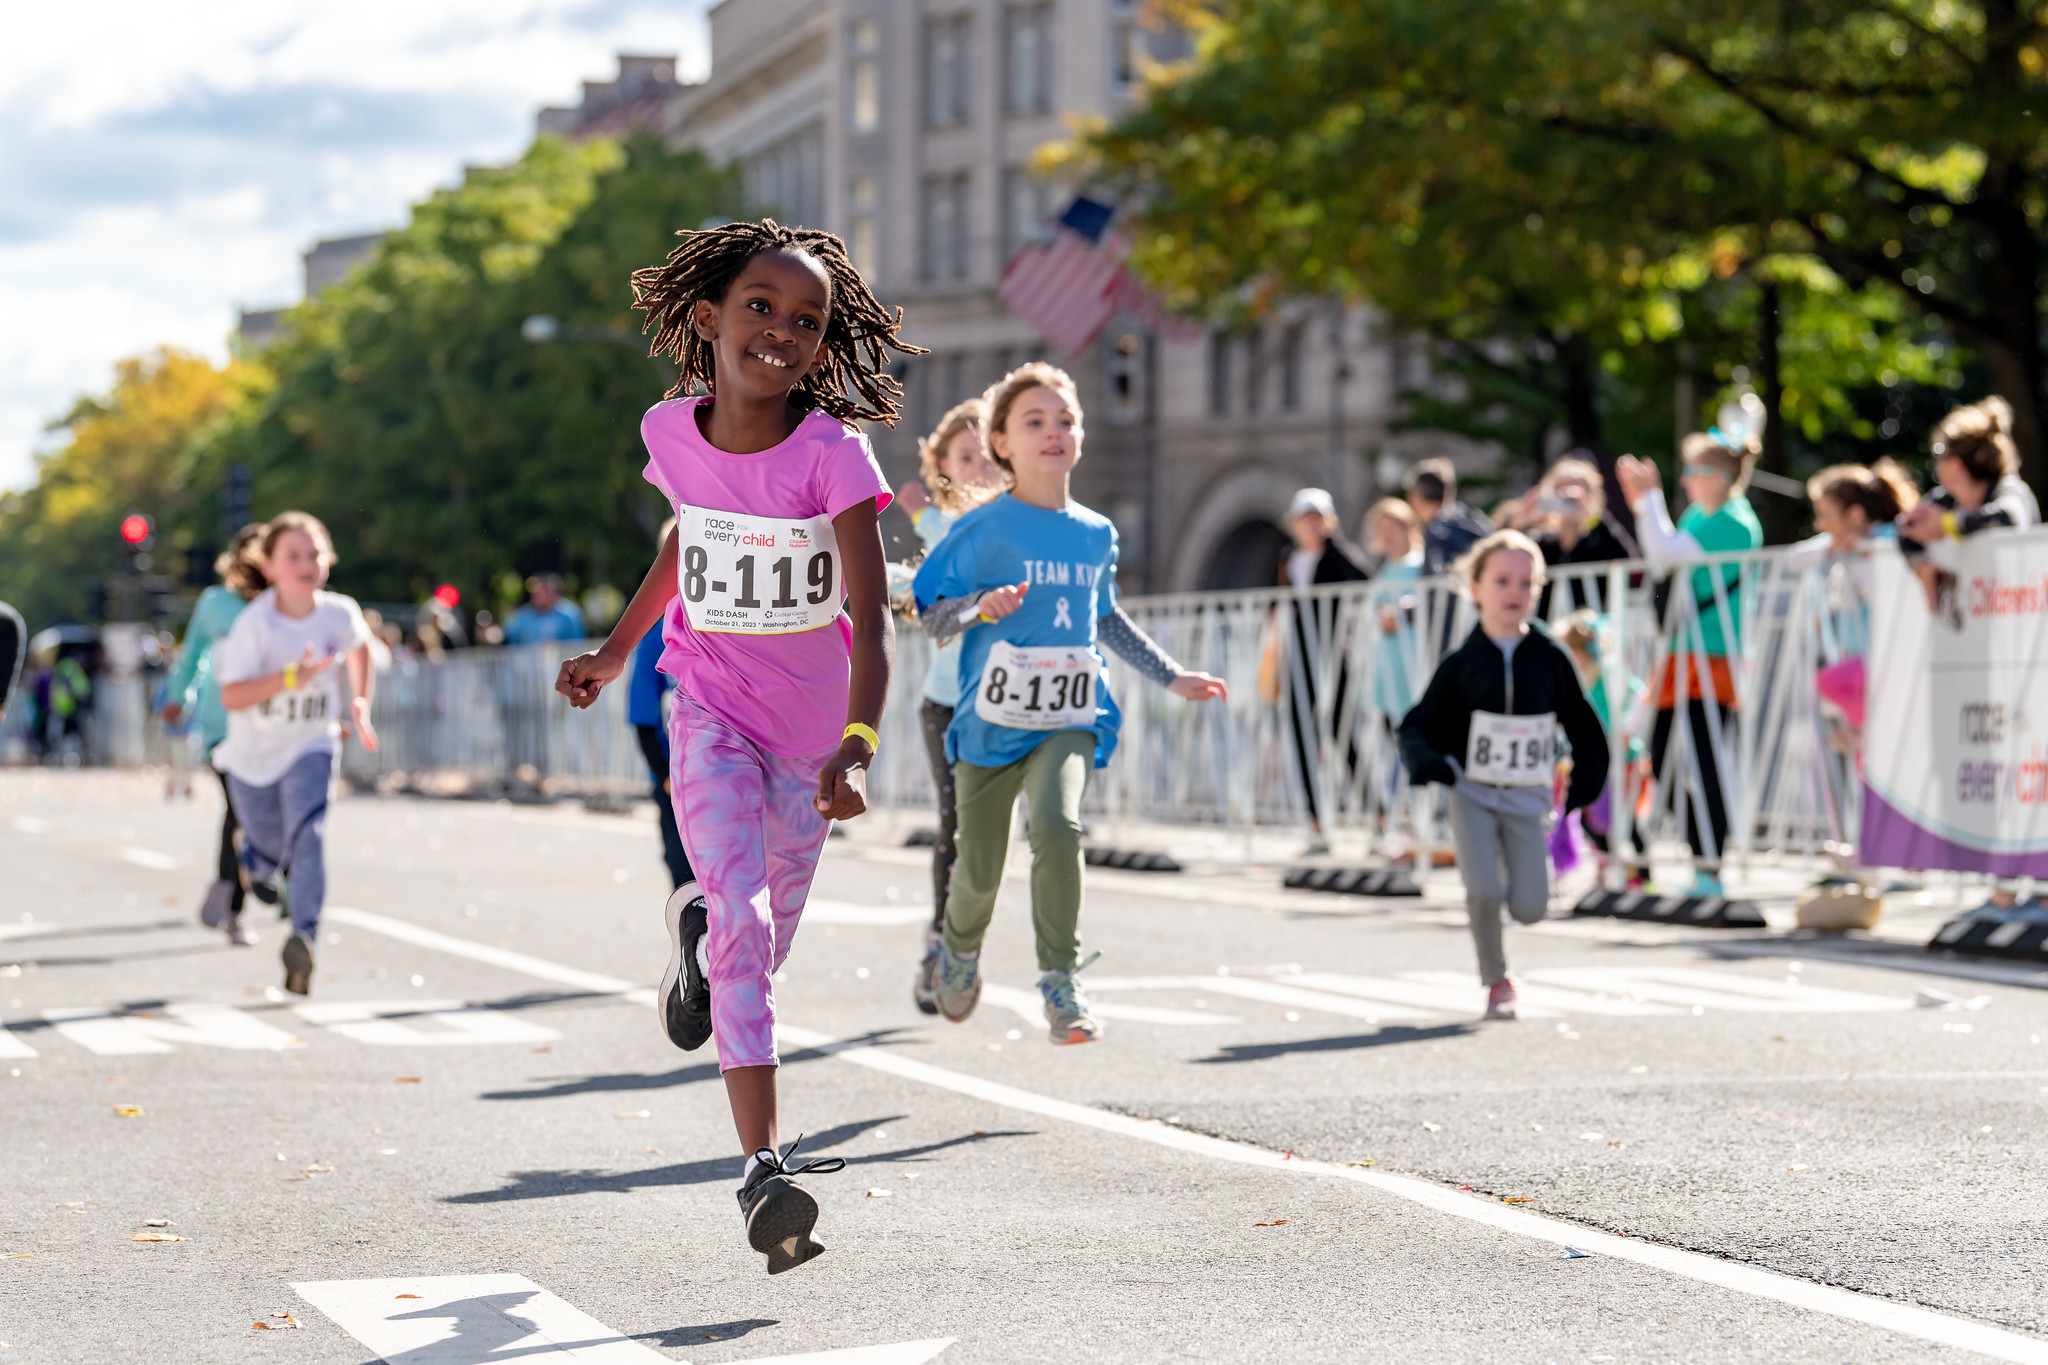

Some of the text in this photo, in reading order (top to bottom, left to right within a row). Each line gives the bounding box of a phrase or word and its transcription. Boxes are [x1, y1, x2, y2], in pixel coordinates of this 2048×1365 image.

[704, 517, 735, 531] race
[704, 529, 775, 547] every child
[684, 545, 833, 609] 8-119
[1022, 560, 1070, 585] TEAM
[706, 608, 748, 619] KIDS DASH
[704, 618, 730, 627] October
[731, 620, 741, 628] 21,
[762, 620, 799, 628] Washington,
[985, 667, 1090, 711] 8-130
